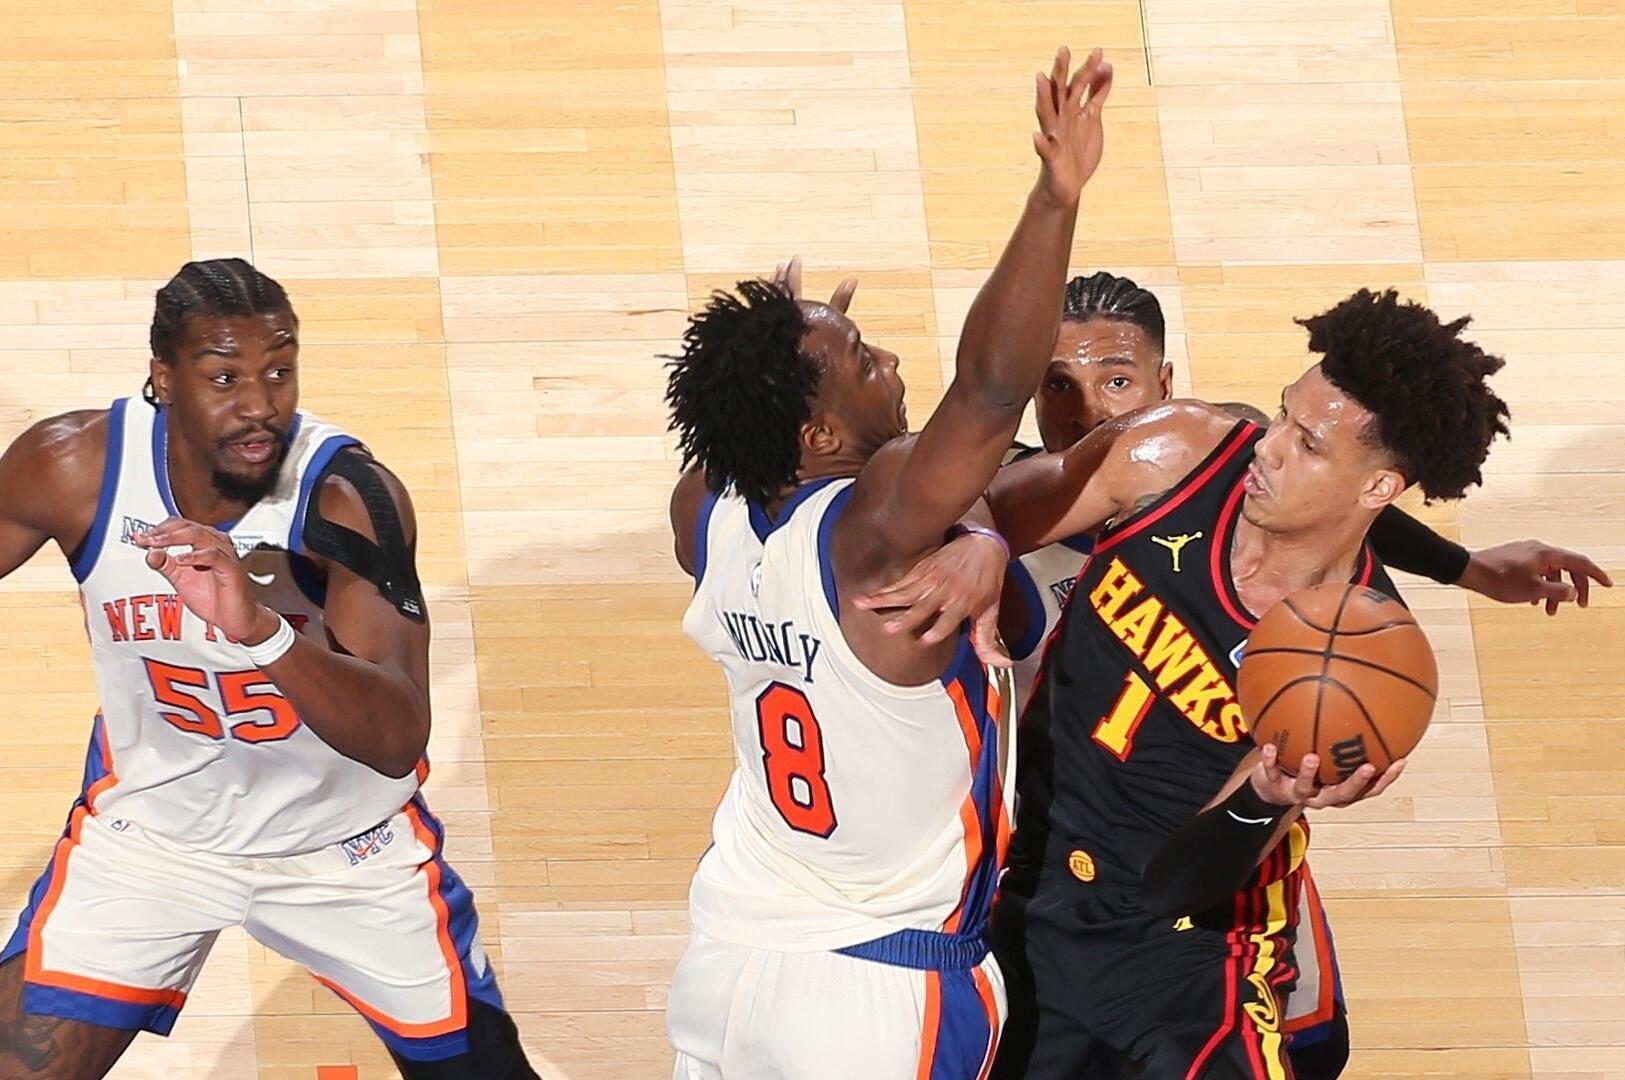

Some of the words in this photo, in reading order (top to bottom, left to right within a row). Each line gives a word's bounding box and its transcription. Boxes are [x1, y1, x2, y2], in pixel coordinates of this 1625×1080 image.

[103, 593, 182, 641] NEW
[1088, 555, 1248, 743] HAWKS
[141, 656, 303, 744] 55
[1091, 670, 1157, 762] 1
[756, 680, 838, 839] 8
[1072, 858, 1092, 875] ATL
